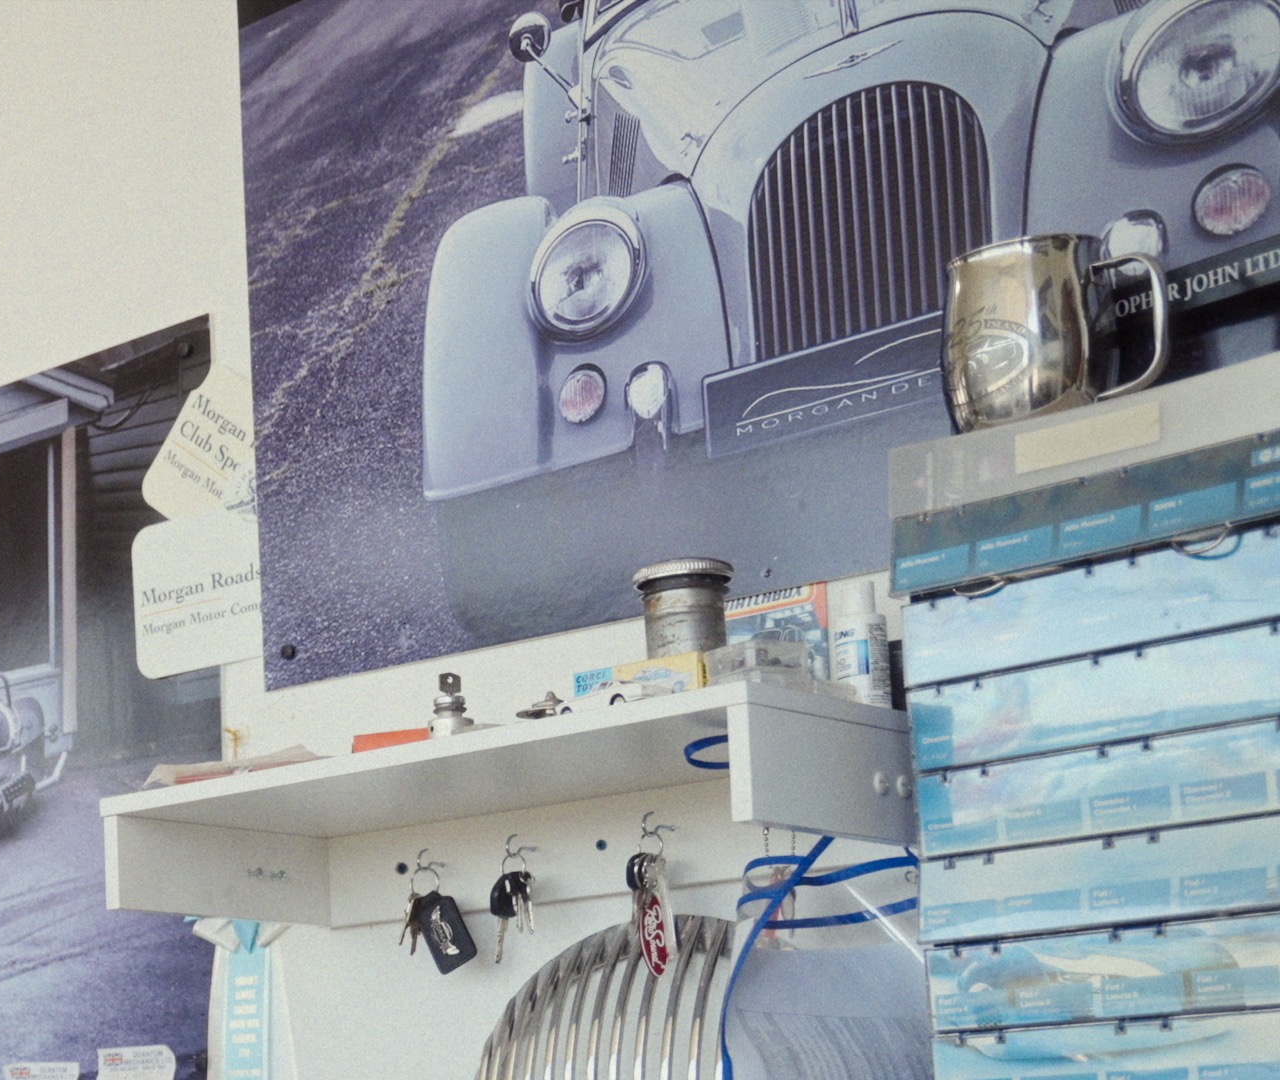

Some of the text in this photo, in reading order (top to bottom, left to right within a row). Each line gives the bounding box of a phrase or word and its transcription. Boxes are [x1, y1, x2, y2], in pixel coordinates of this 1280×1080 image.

[1184, 262, 1239, 301] JOHN
[1245, 249, 1280, 276] LTD
[192, 394, 246, 441] Morgan
[736, 391, 878, 437] MORGAN
[180, 420, 212, 453] Club
[163, 450, 200, 484] Morgan
[141, 583, 204, 607] Morgan
[142, 619, 185, 636] Morgan
[190, 610, 227, 625] Motor
